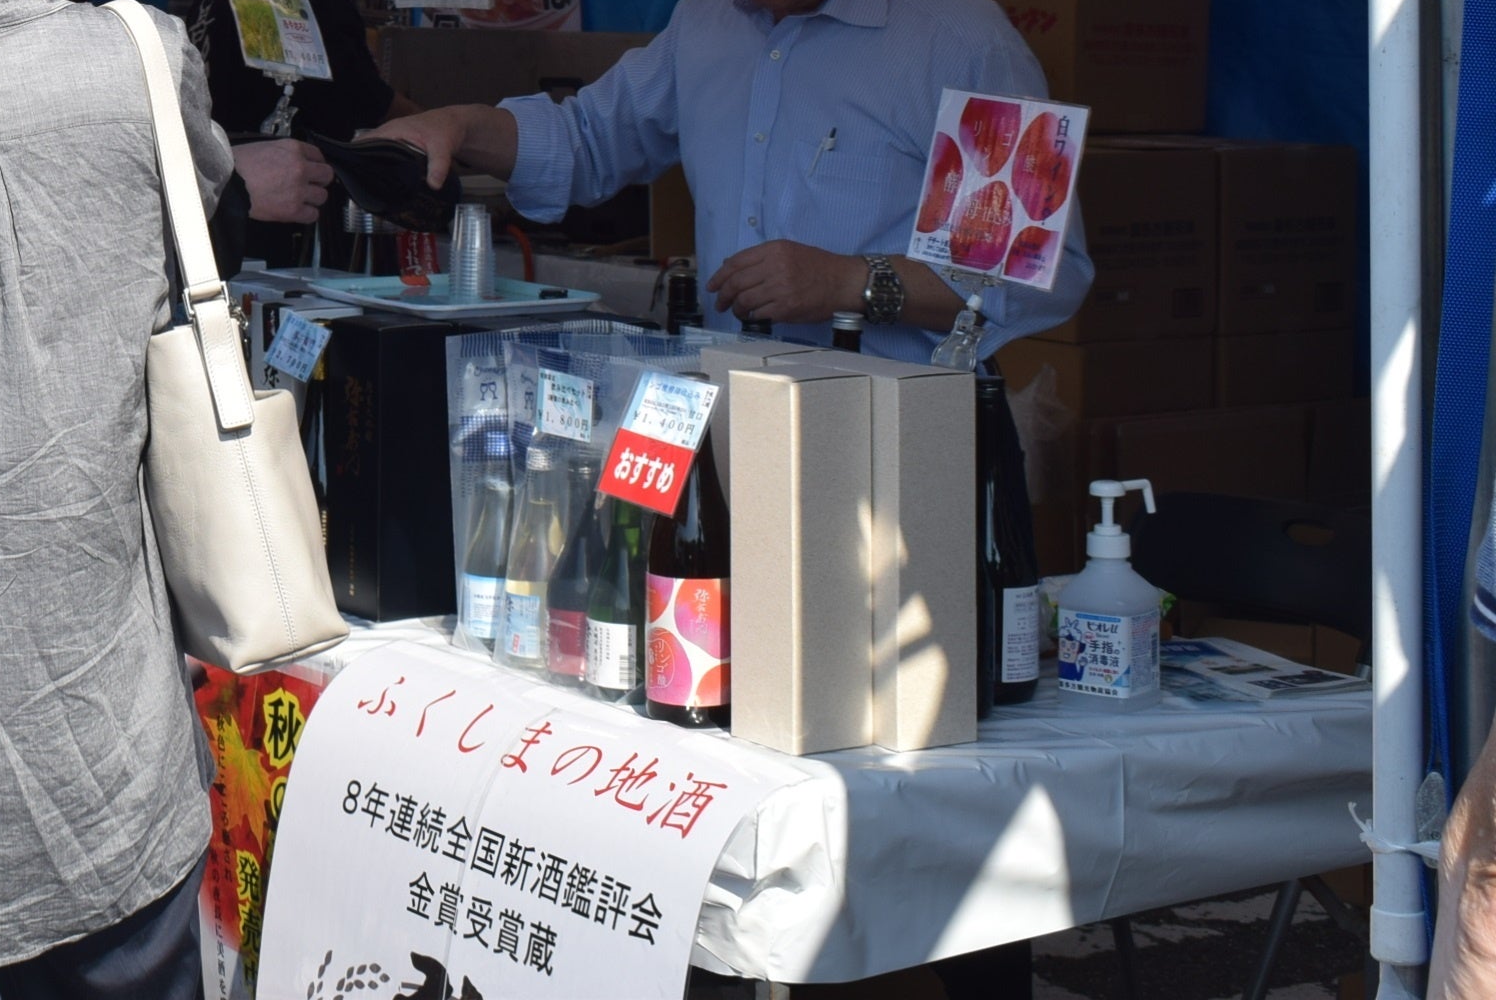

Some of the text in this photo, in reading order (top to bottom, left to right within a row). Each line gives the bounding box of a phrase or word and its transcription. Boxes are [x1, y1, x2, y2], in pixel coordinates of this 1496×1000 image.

[613, 446, 675, 494] おすすめ
[1088, 653, 1121, 668] 消毒液
[1089, 640, 1121, 655] 手指の
[356, 676, 729, 840] ふくしまの地酒
[340, 778, 664, 947] 8年連続全国新酒鑑評会
[405, 870, 560, 977] 金賞受賞蔵
